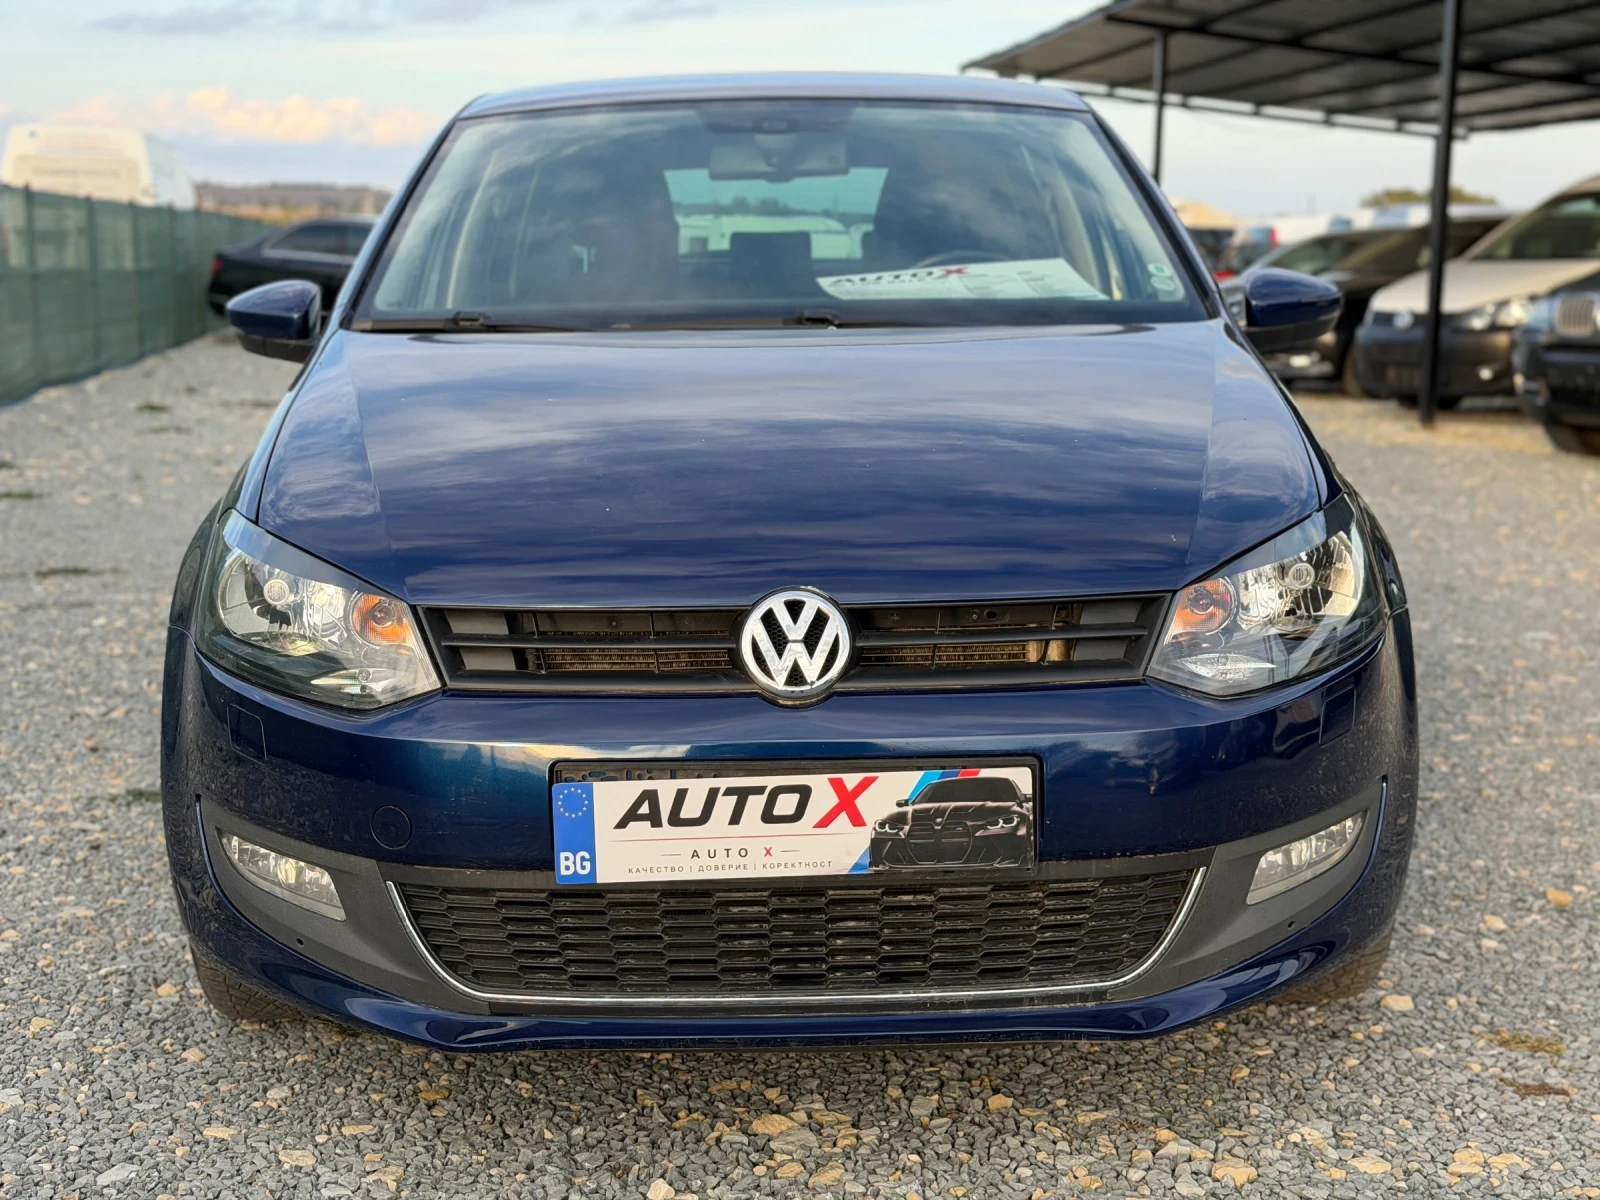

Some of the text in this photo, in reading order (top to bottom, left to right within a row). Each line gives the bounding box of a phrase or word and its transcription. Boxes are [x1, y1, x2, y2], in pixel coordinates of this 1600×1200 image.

[691, 846, 773, 859] AUTO X
[560, 851, 591, 876] BG
[628, 860, 833, 874] КАЧЕСТВО ДОВЕРИЕ КОРЕКТНОСТ
